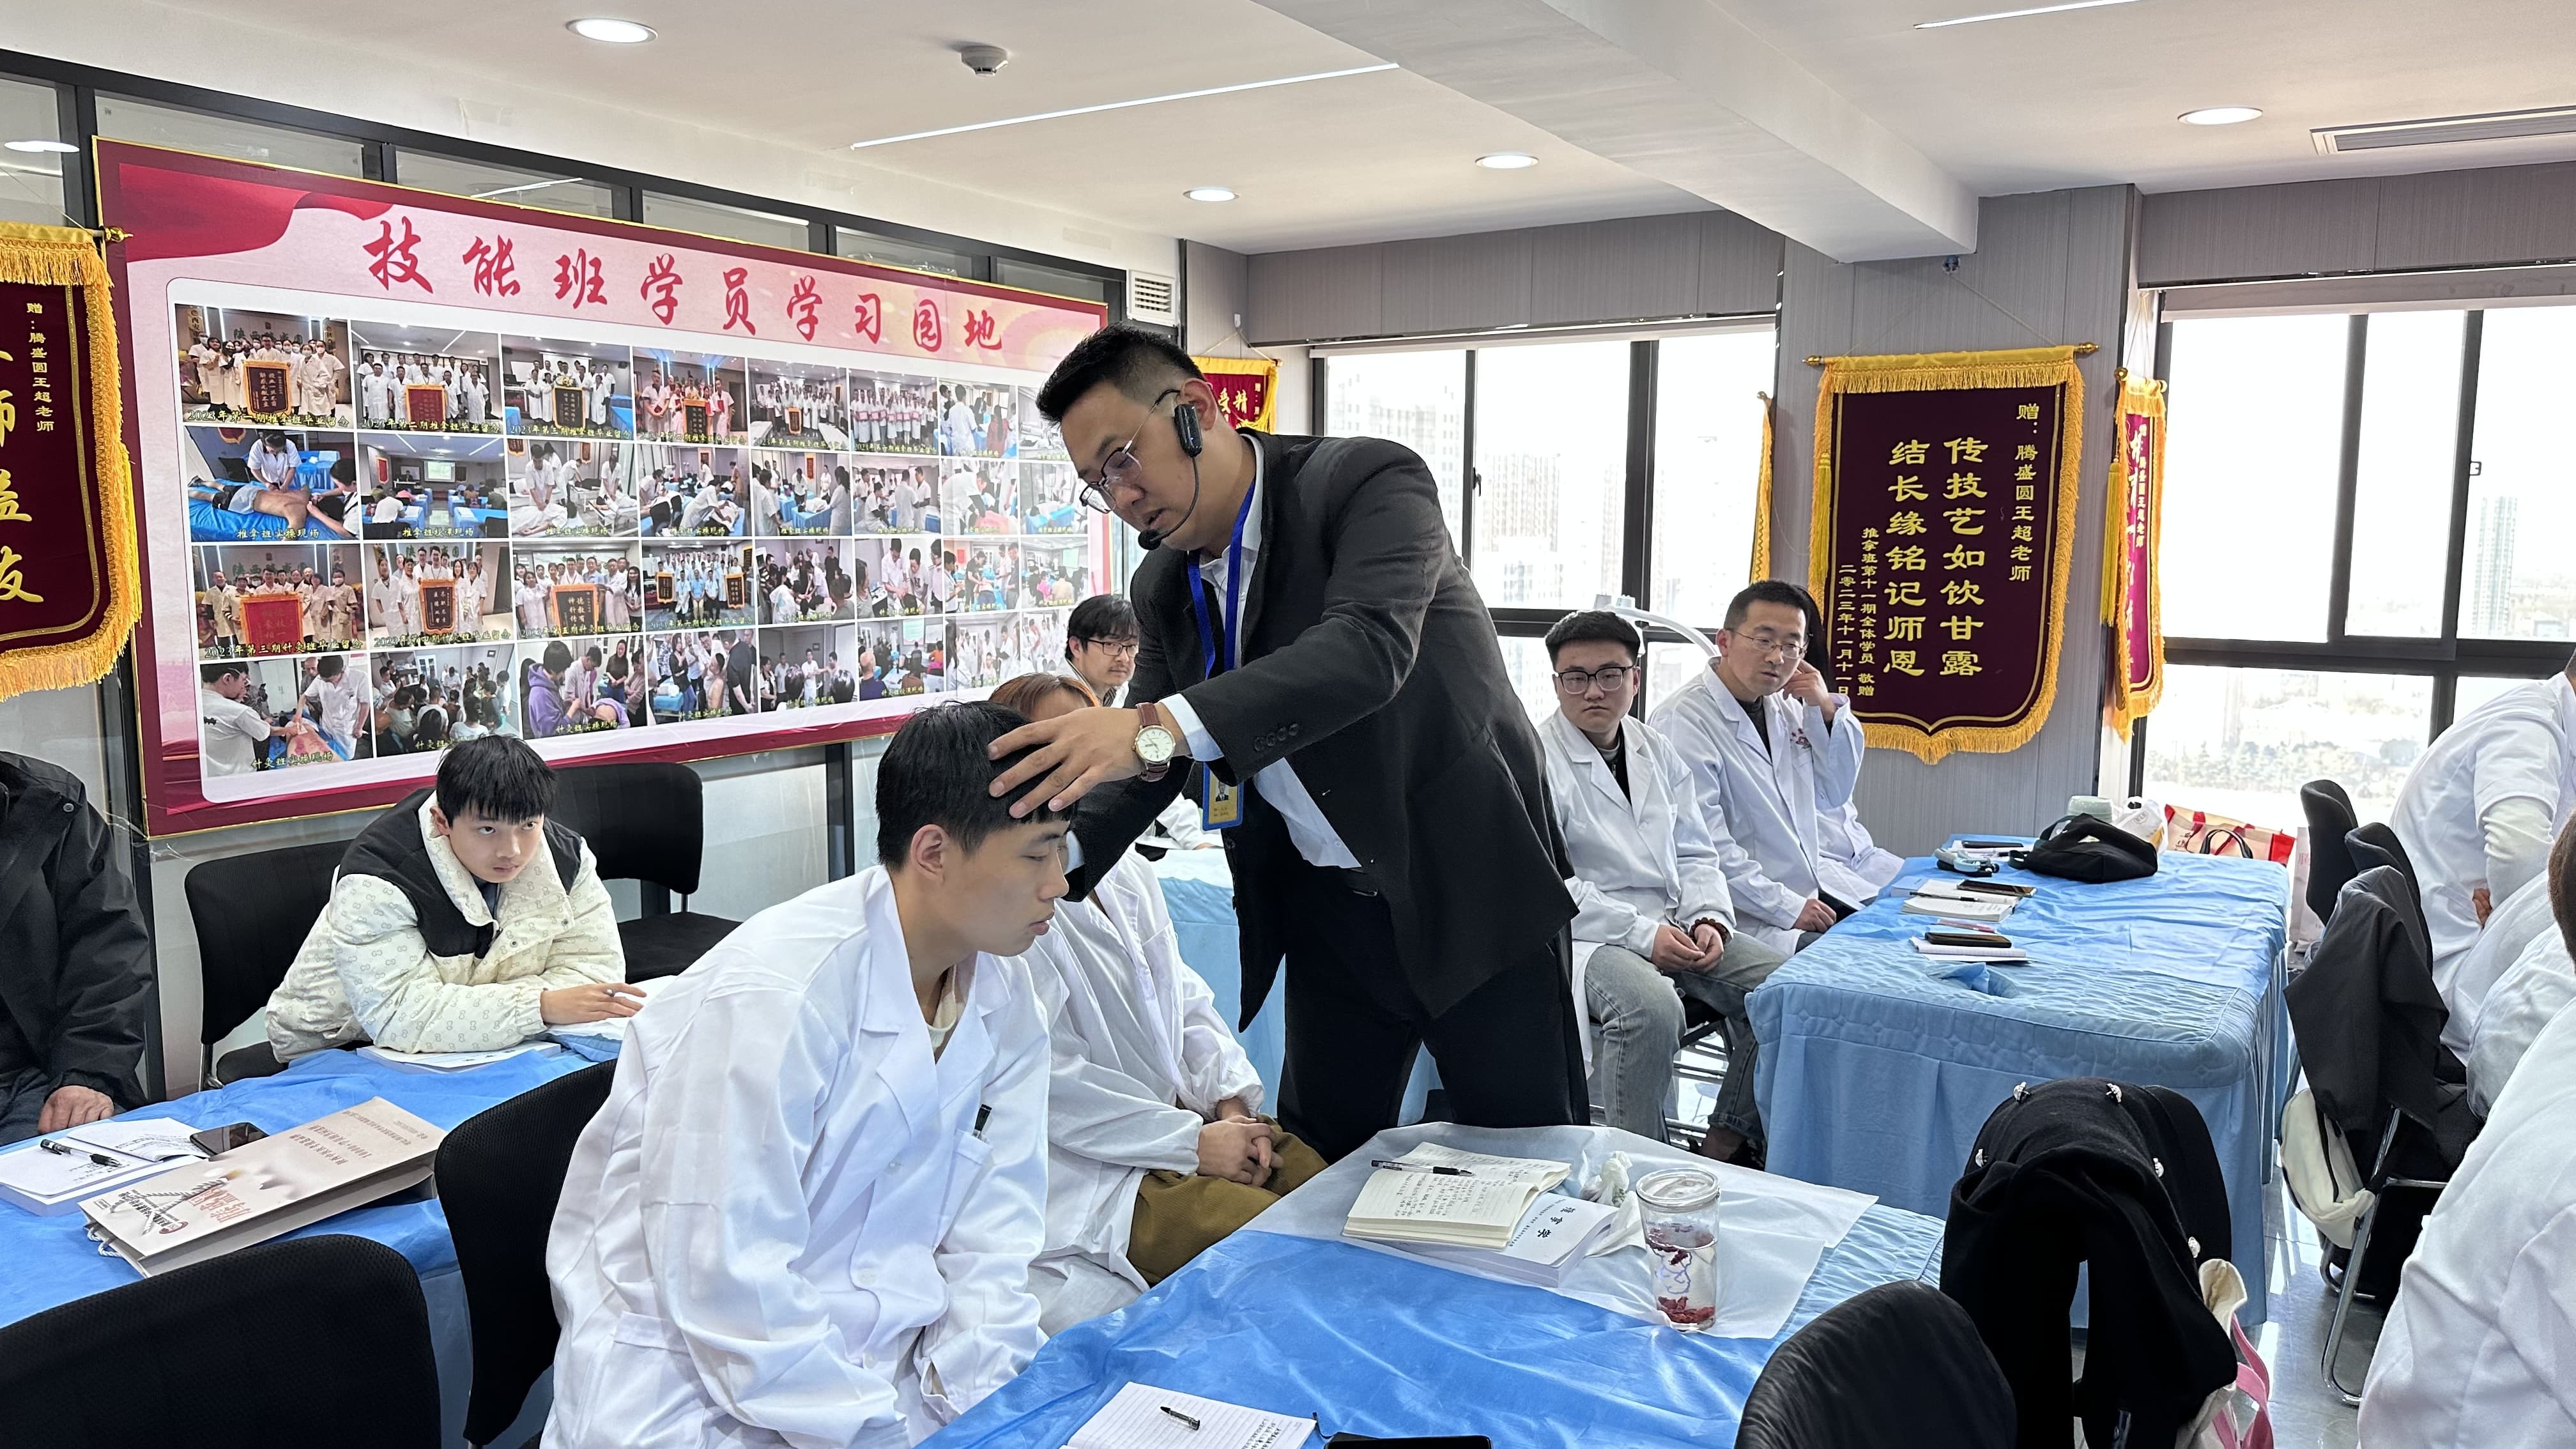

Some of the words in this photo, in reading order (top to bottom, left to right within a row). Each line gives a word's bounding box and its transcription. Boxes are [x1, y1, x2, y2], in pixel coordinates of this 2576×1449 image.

[363, 217, 1003, 352] 技能班学员学习园地
[1883, 440, 1930, 676] 结长缘铭记师恩
[1939, 437, 1988, 677] 传技艺如饮甘露
